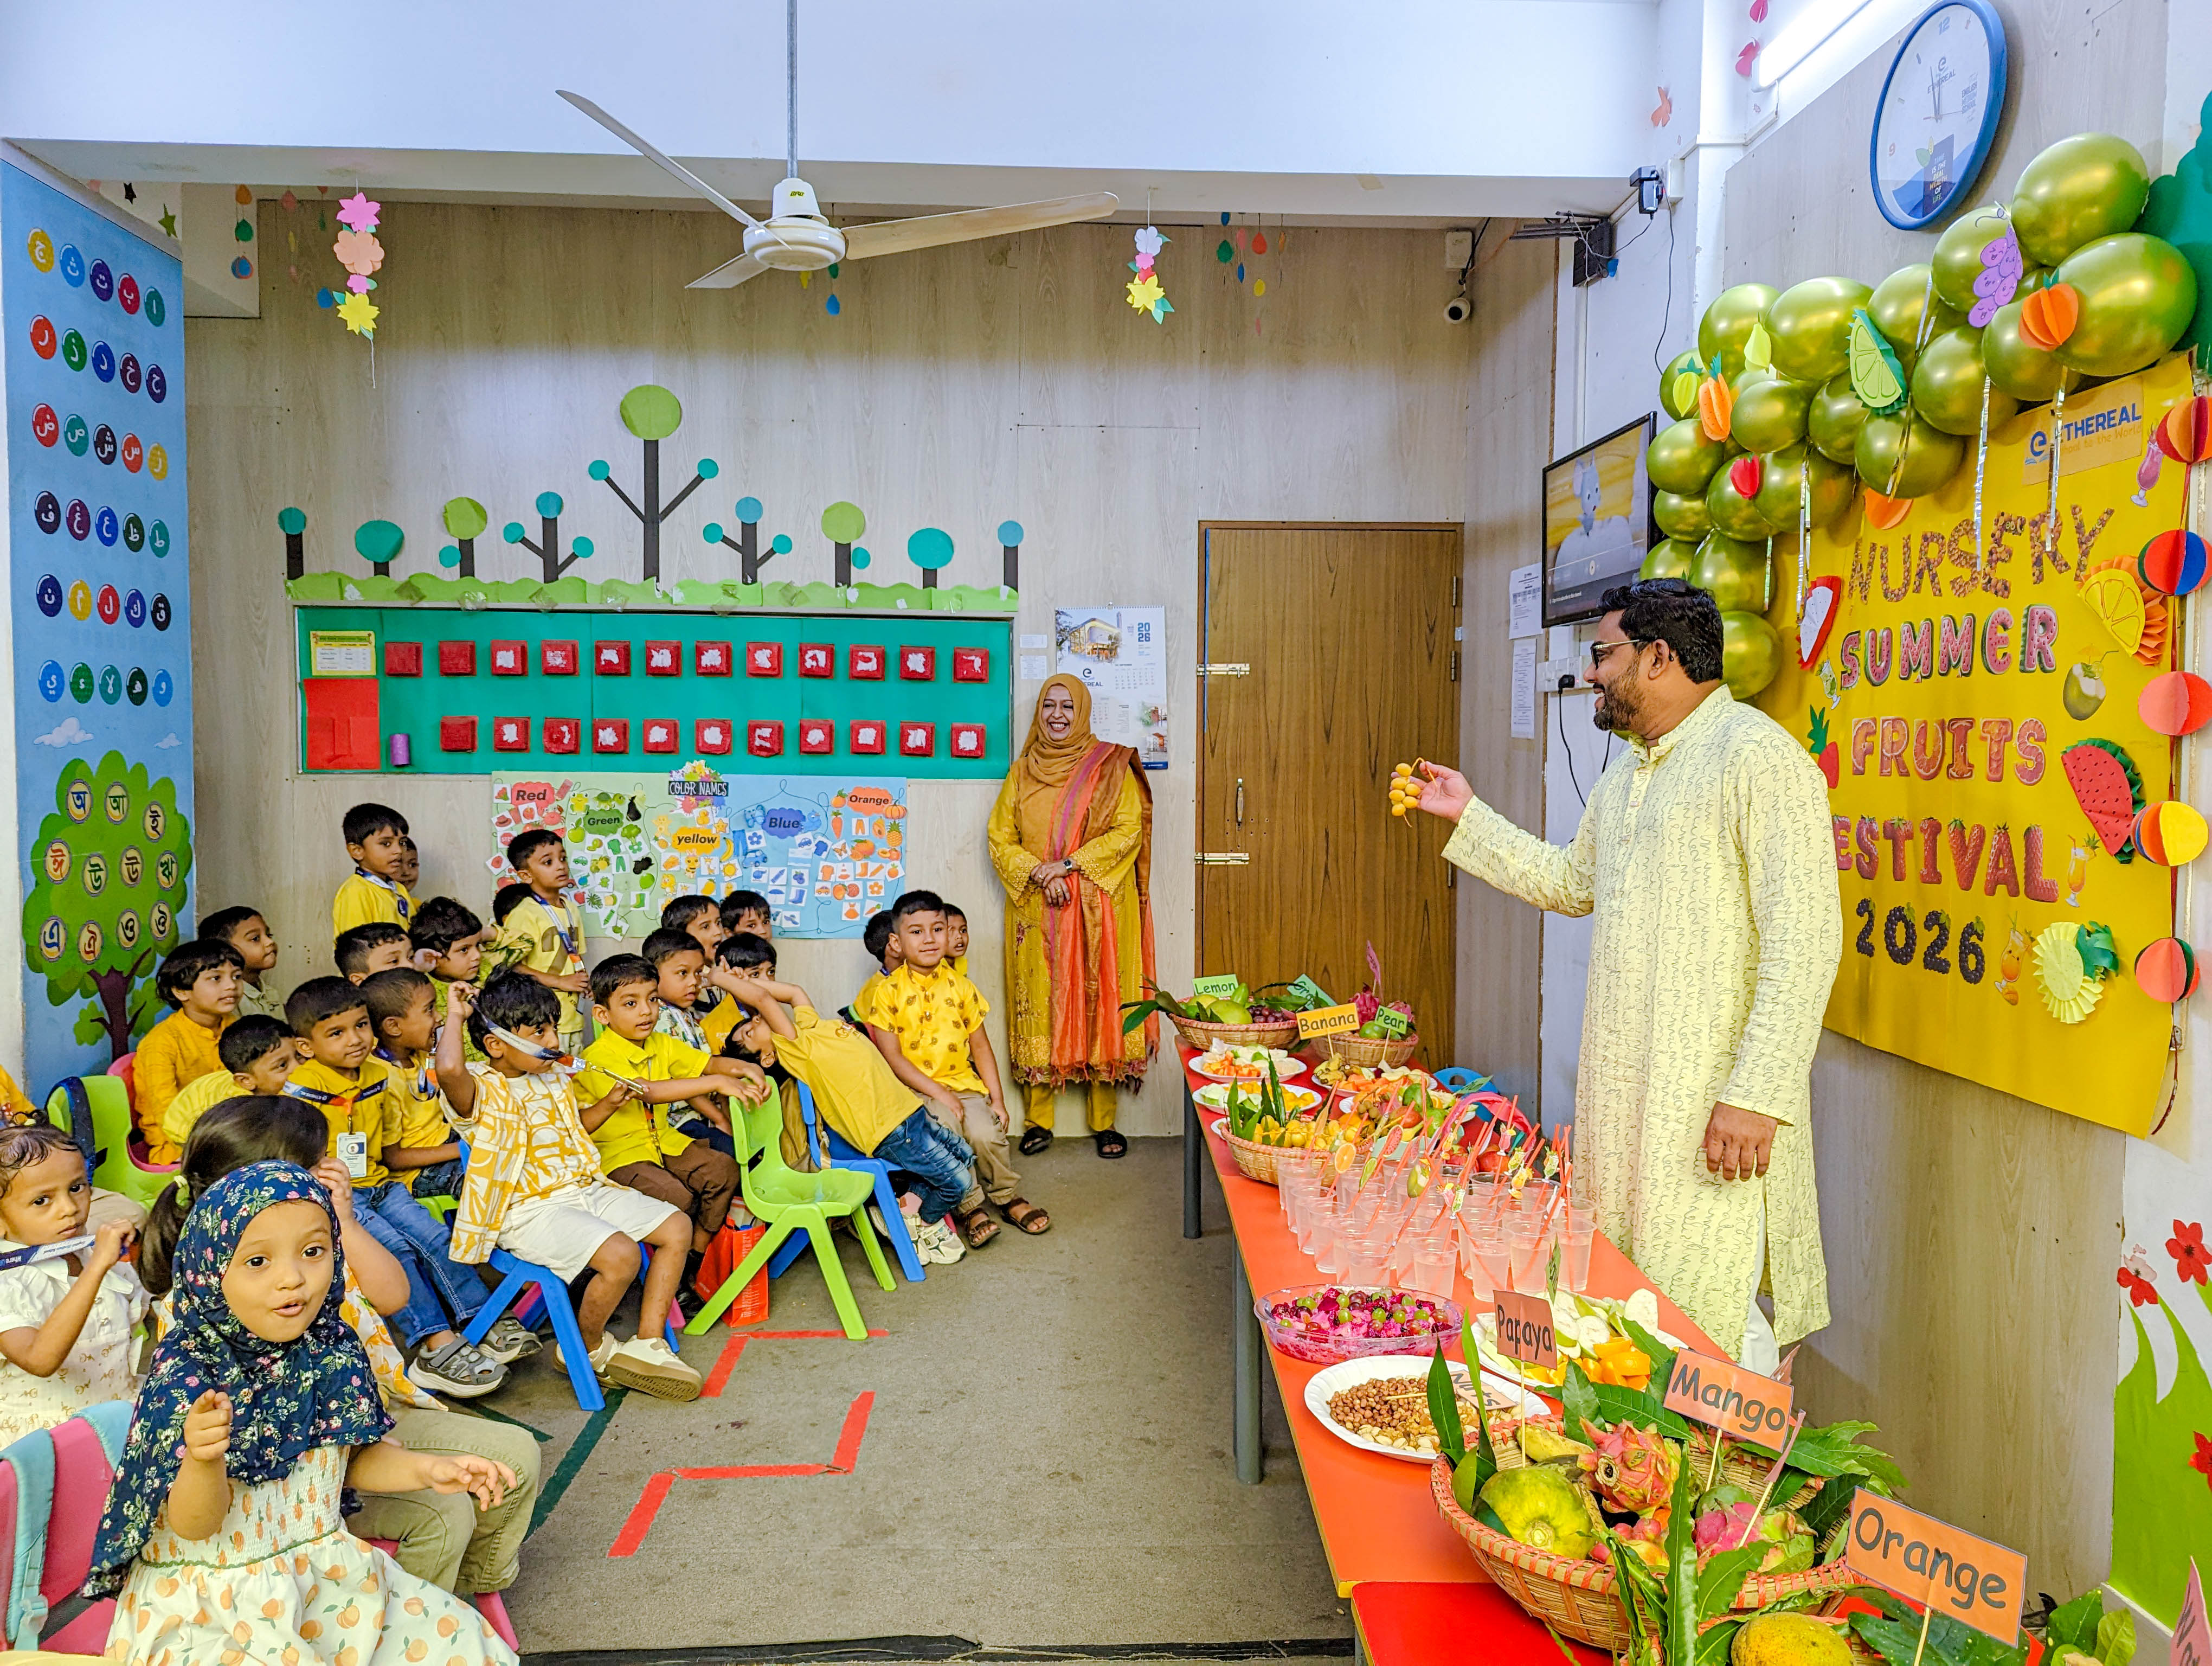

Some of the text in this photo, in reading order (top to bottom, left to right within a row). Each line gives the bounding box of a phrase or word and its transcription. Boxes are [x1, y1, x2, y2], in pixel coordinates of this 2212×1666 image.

[1939, 17, 1950, 35] 12
[1888, 143, 1896, 157] 9
[1935, 185, 1941, 195] OF
[34, 240, 157, 314] ا ب ت ث ج
[126, 361, 136, 386] خ
[152, 374, 160, 393] ح
[36, 414, 162, 472] ز س ش ص ض
[41, 504, 165, 547] ط ظ ع غ ف
[1847, 505, 2114, 605] NURSERY
[44, 588, 55, 604] ن
[104, 595, 113, 614] ل
[156, 603, 166, 622] ق
[1137, 622, 1150, 632] 20
[1137, 632, 1150, 642] 26
[1840, 603, 2060, 690] SUMMER
[159, 682, 166, 695] و
[1851, 717, 2047, 786] FRUITS
[516, 789, 547, 801] Red
[670, 781, 727, 796] COLOR NAMES
[72, 791, 87, 813] অ
[109, 794, 126, 814] আ
[849, 794, 890, 806] Orange
[588, 817, 620, 826] Green
[769, 817, 800, 829] Blue
[677, 834, 718, 845] yellow
[1832, 815, 2060, 902] ESTIVAL
[44, 921, 61, 952] এ
[1855, 898, 1986, 985] 2026
[1194, 983, 1236, 994] Lemon
[1299, 1014, 1355, 1033] Banana
[1377, 1008, 1405, 1029] Pear
[1497, 1304, 1553, 1360] Papaya
[1671, 1364, 1786, 1432] Mango
[1855, 1508, 2007, 1610] Orange
